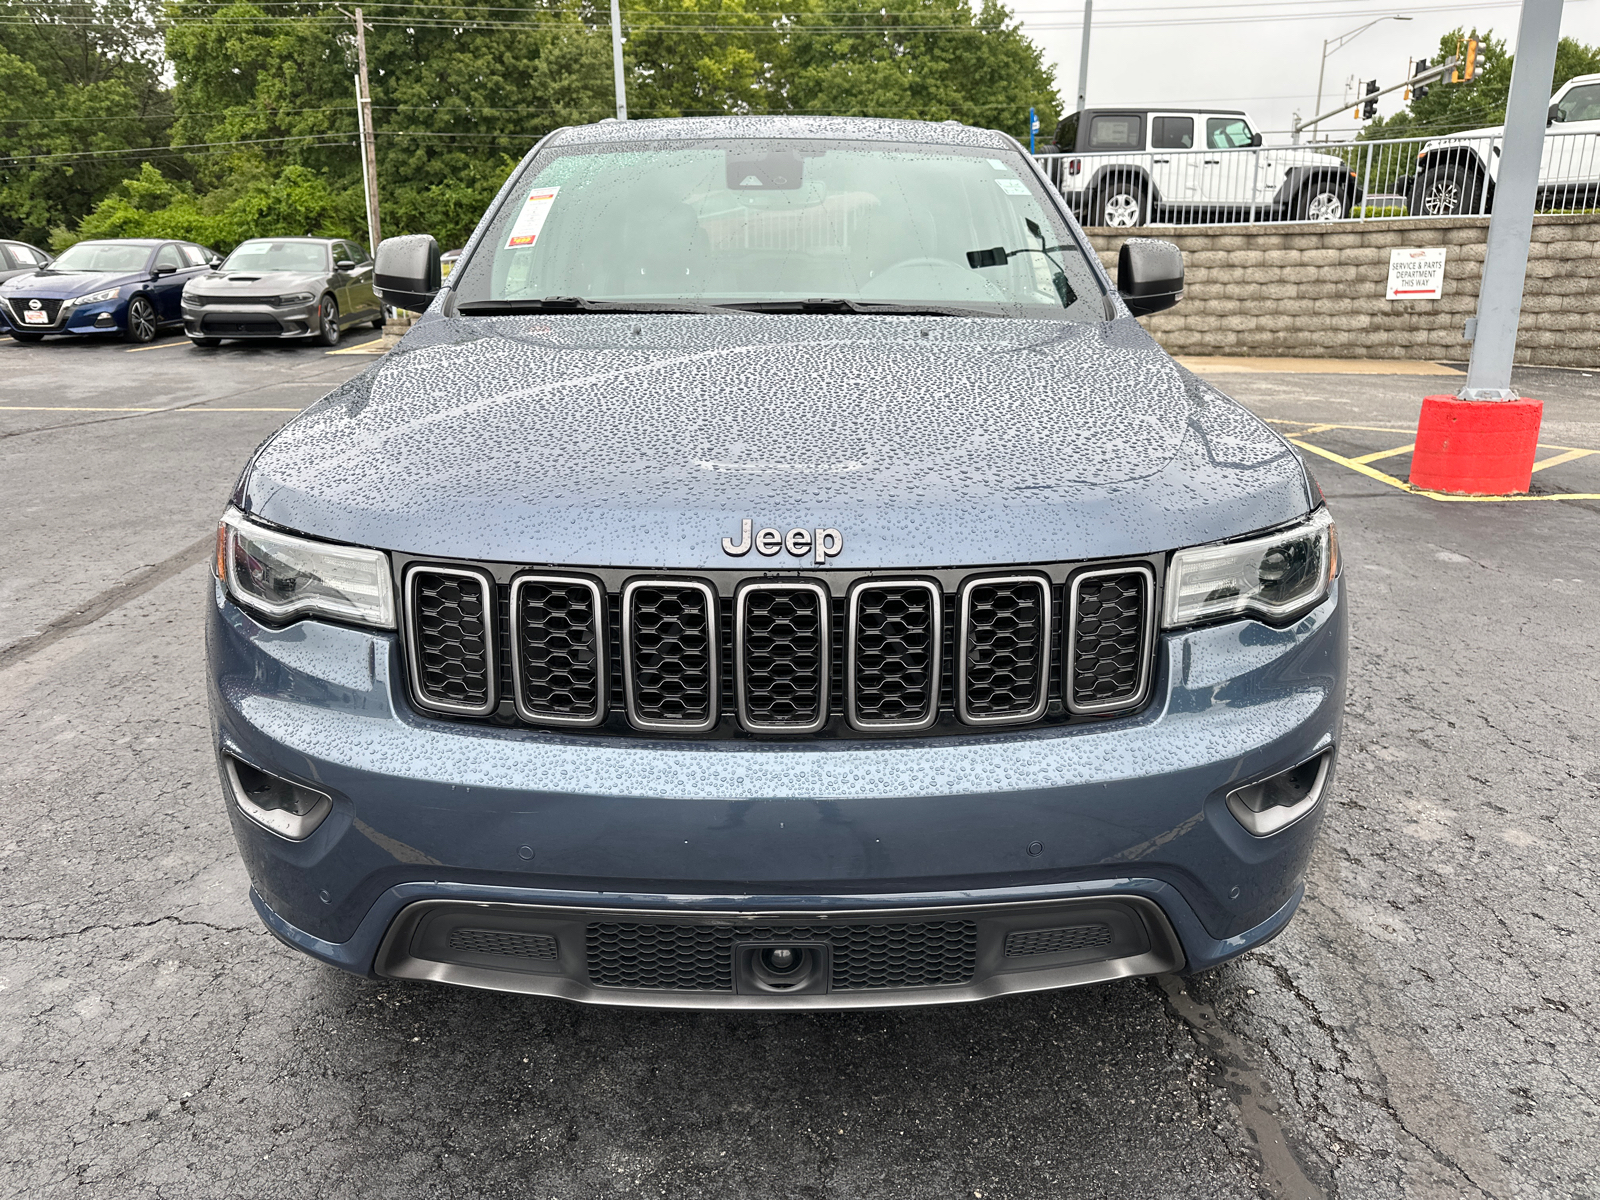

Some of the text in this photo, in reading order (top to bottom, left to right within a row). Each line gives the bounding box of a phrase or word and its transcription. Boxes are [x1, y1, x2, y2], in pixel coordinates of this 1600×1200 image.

[1392, 262, 1416, 270] SERVICE
[1424, 261, 1442, 269] PARTS
[1396, 270, 1436, 278] DEPARTMENT
[1401, 278, 1430, 287] THIS WAY
[721, 518, 843, 565] Jeep
